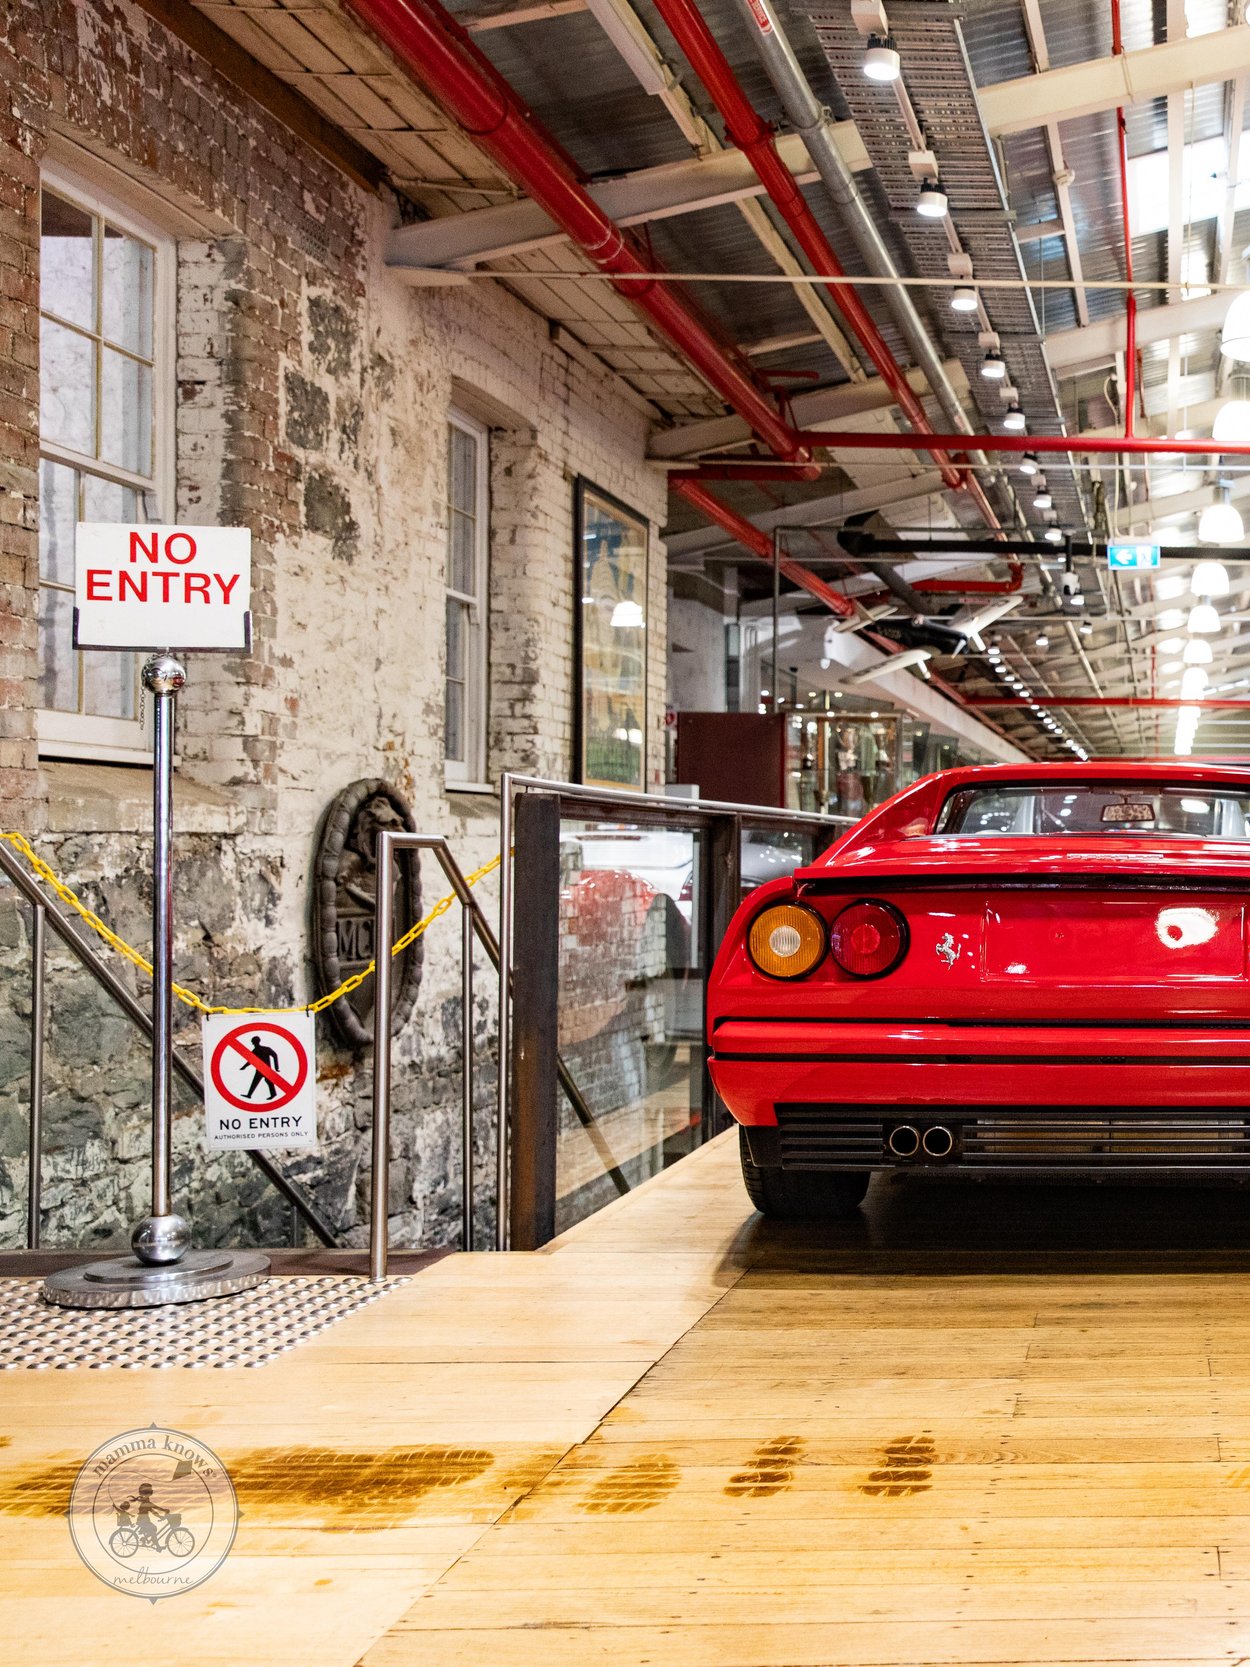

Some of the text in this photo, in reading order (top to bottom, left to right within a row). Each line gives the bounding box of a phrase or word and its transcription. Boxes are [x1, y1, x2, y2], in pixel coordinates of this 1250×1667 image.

[129, 531, 197, 565] NO
[86, 569, 241, 605] ENTRY
[219, 1116, 302, 1131] NO ENTRY
